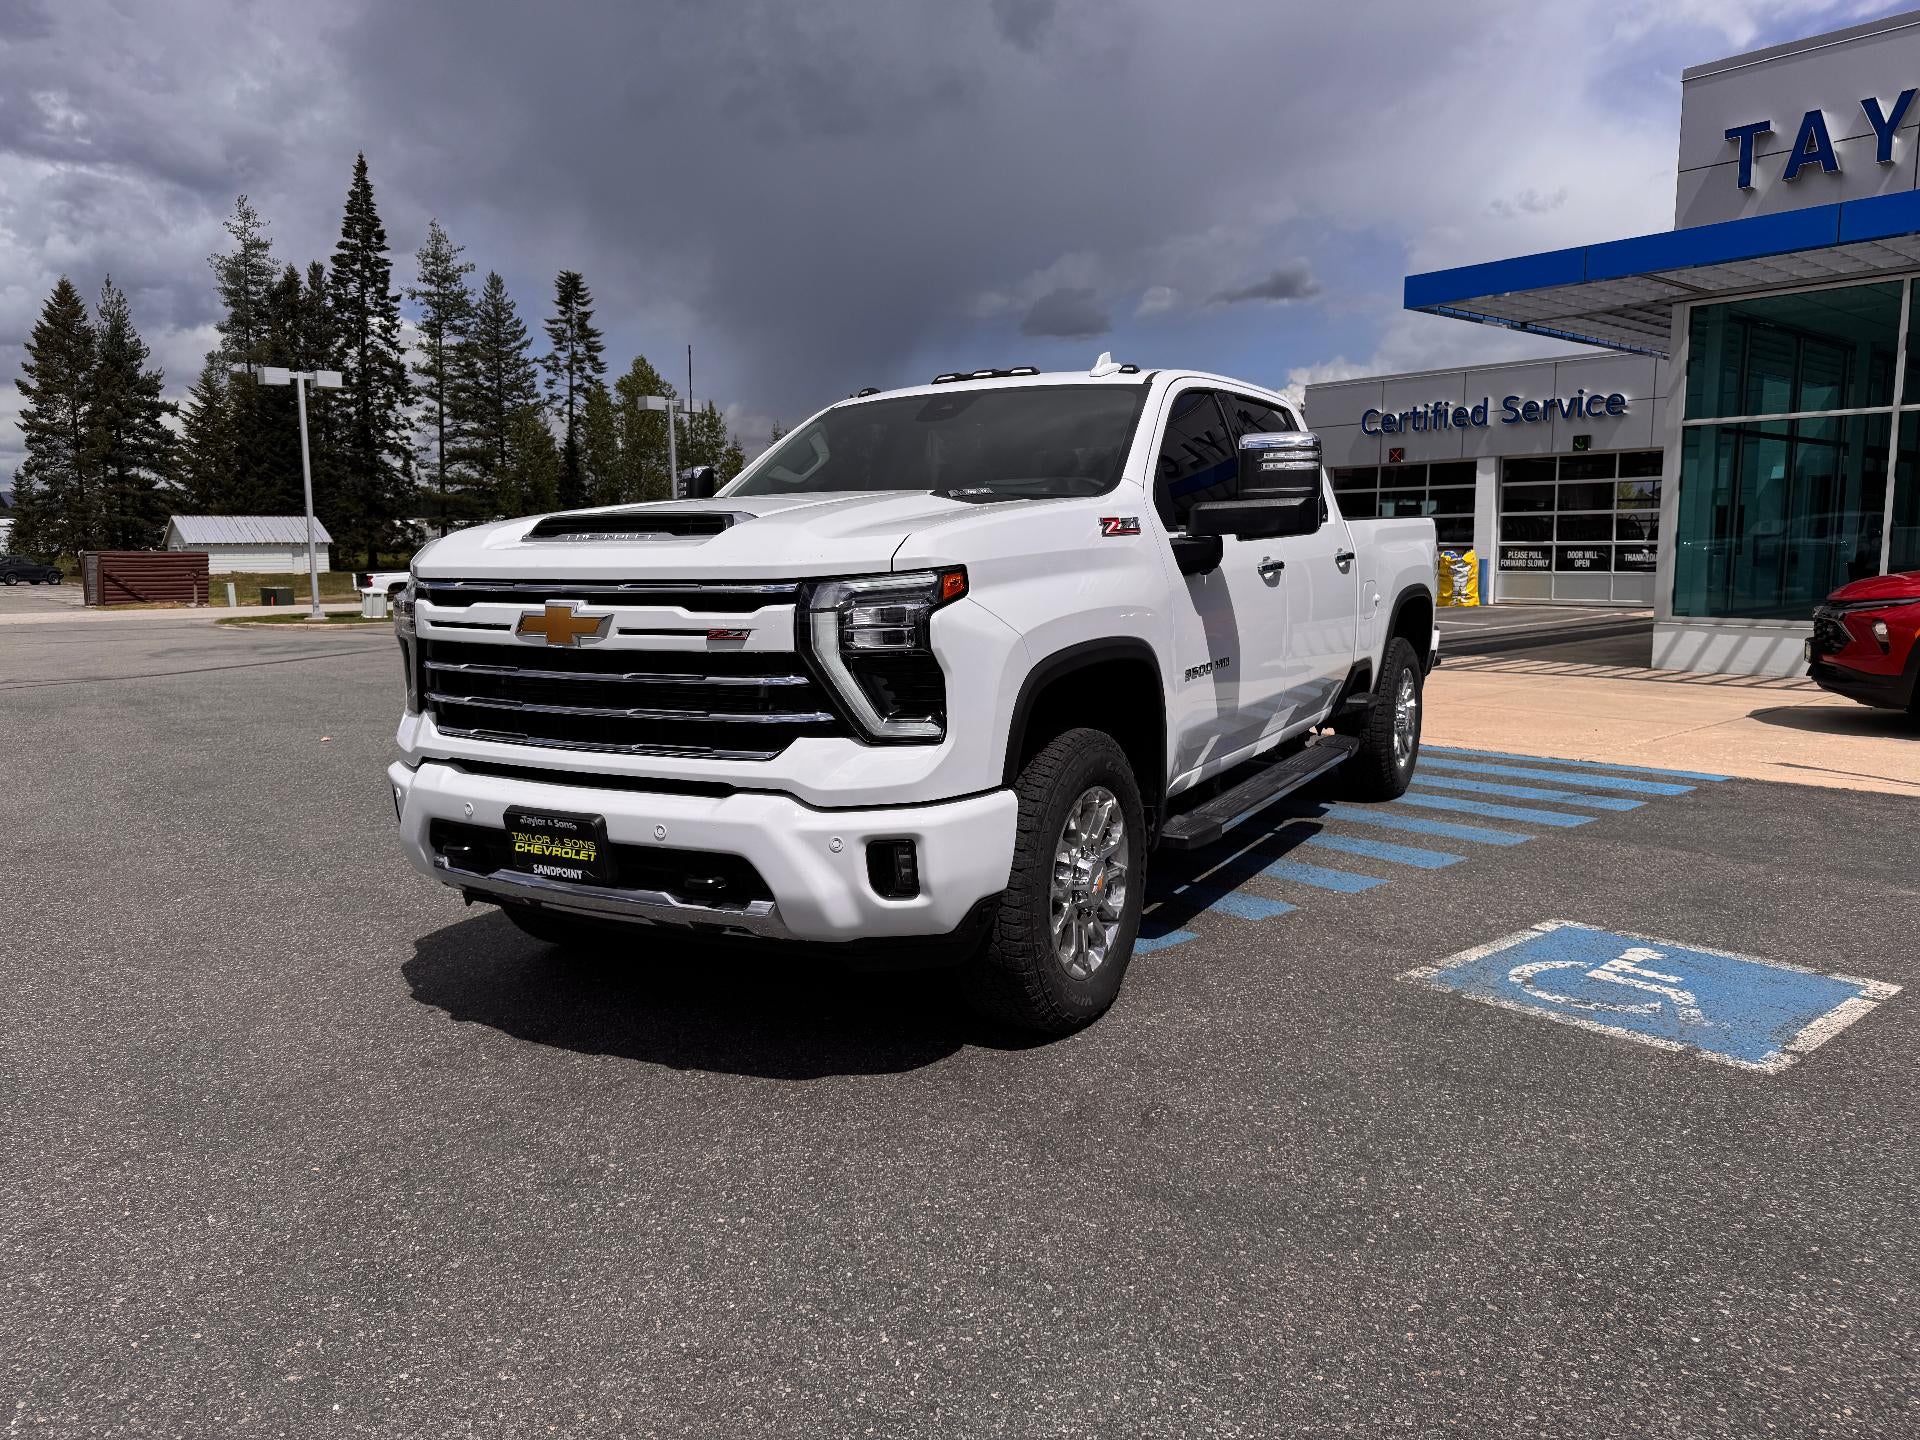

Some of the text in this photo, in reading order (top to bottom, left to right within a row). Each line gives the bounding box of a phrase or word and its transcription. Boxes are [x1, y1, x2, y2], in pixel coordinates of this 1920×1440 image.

[1724, 87, 1919, 190] TAY
[1361, 388, 1628, 436] Certified Service
[1099, 517, 1141, 537] Z71
[1507, 551, 1543, 559] PLEASE PULL
[1567, 550, 1598, 559] DOOR WILL
[1624, 553, 1644, 562] THANK
[1500, 559, 1549, 567] FORWARD SLOWLY
[1574, 559, 1590, 568] OPEN
[521, 815, 546, 827] Taylor
[511, 831, 596, 850] TAYLOR & SONS
[514, 842, 597, 862] CHEVROLET
[532, 863, 583, 880] SANDPOINT
